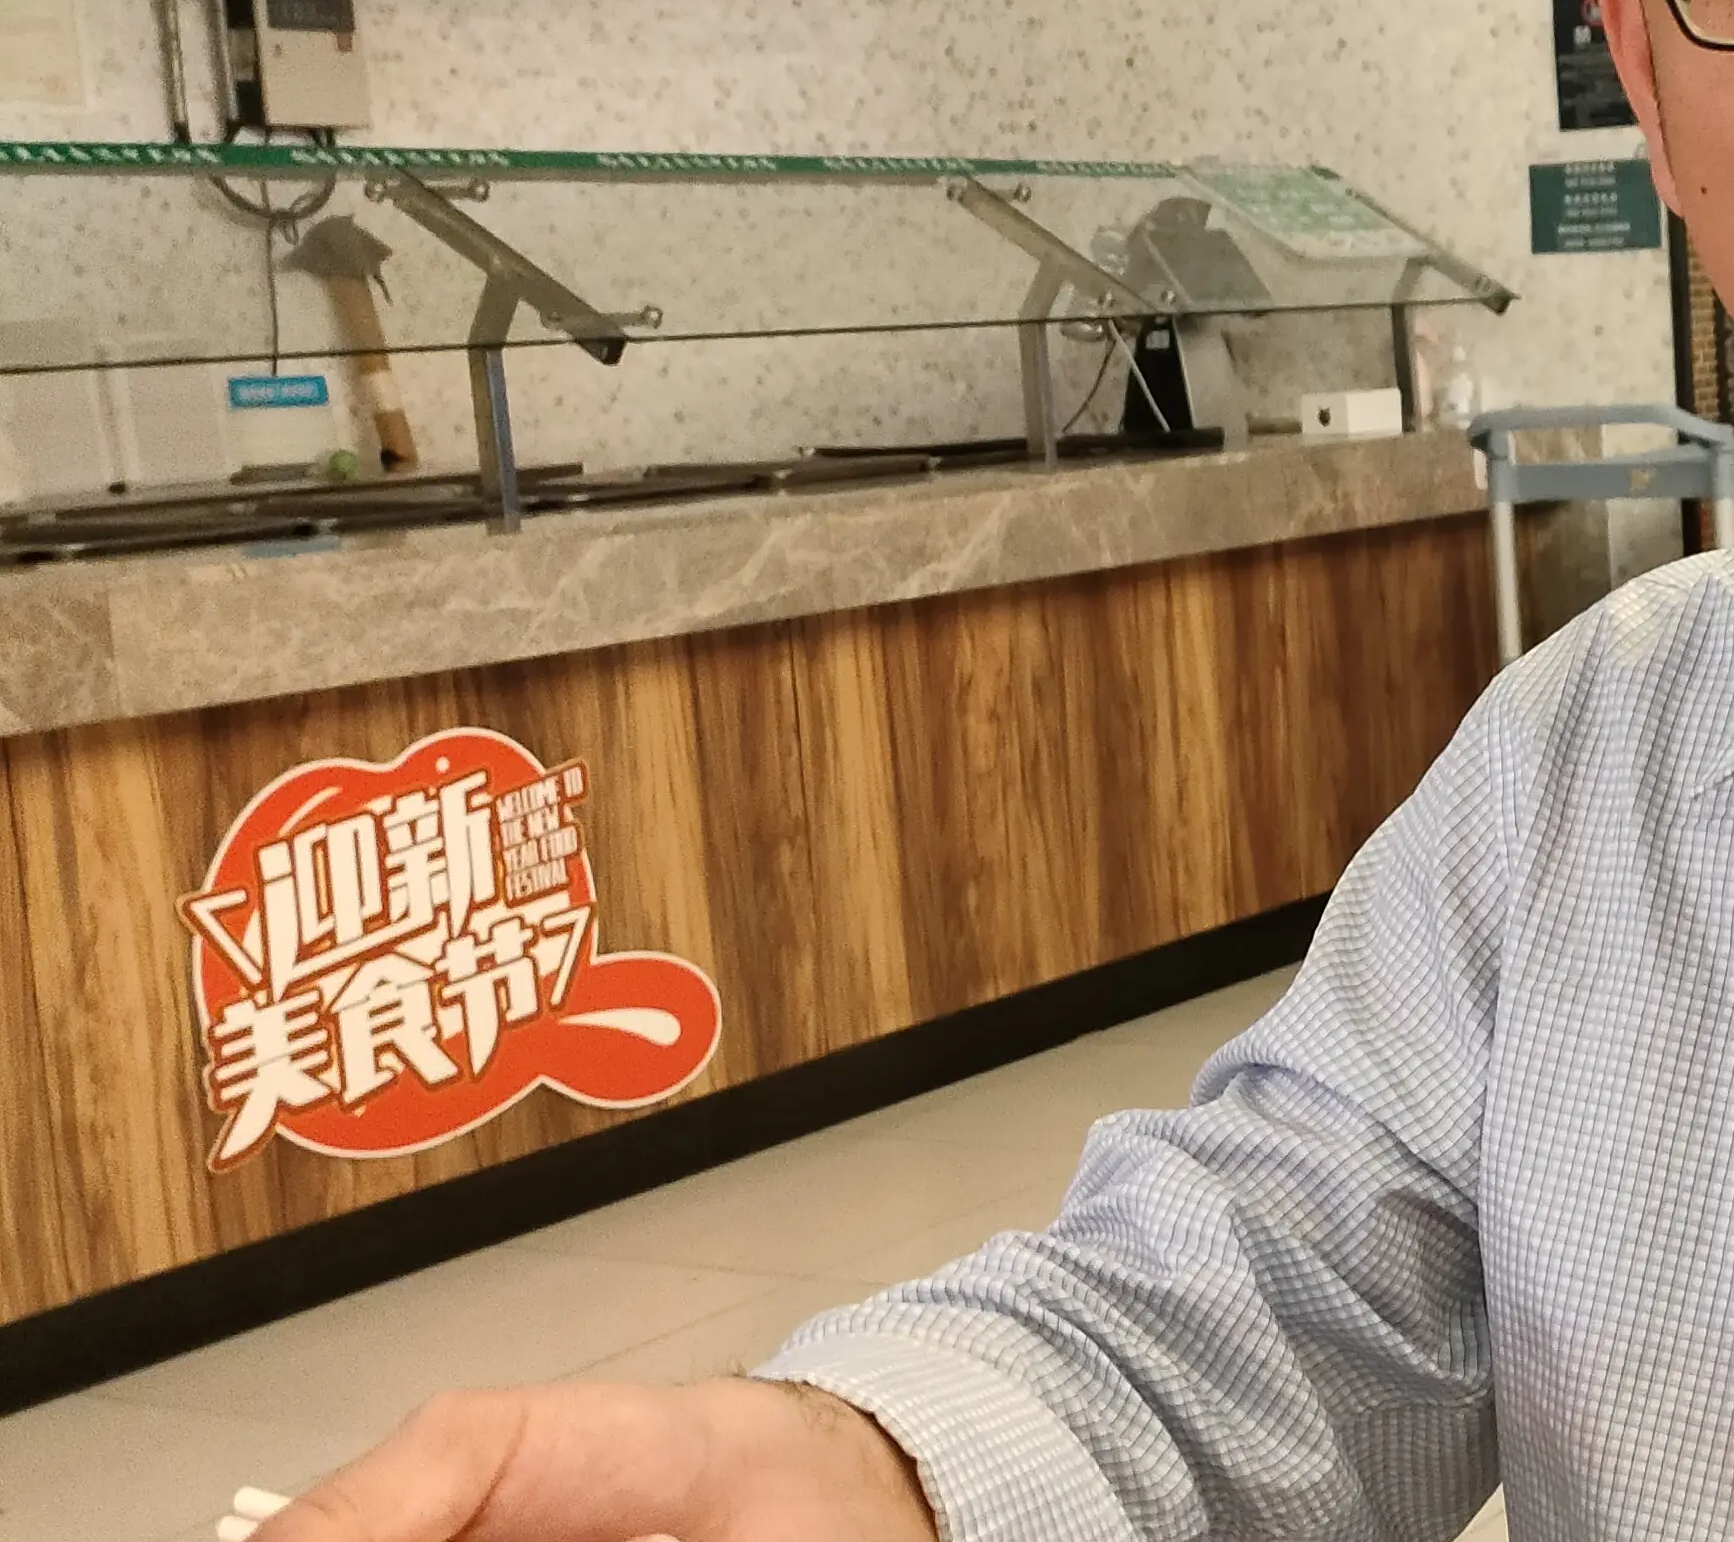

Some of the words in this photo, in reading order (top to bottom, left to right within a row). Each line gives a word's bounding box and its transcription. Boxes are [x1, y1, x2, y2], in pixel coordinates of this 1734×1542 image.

[257, 770, 496, 999] 迎新
[212, 914, 541, 1161] 美食节
